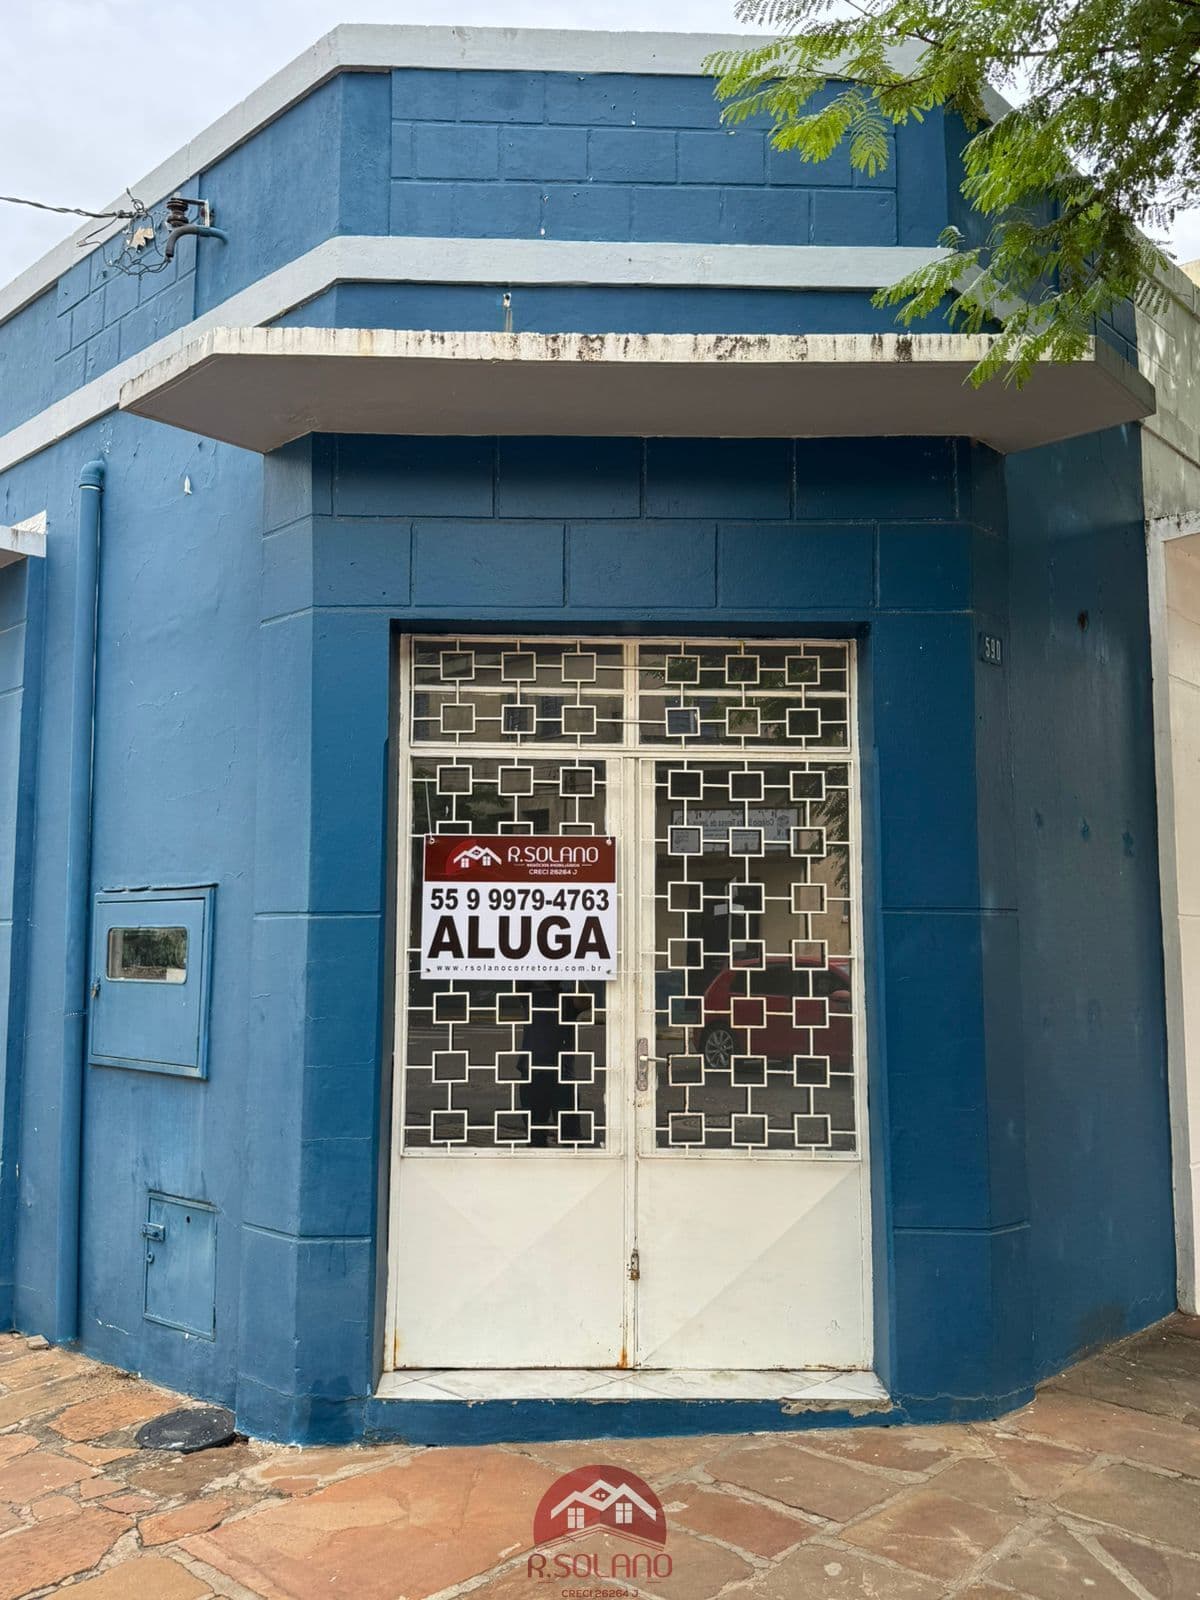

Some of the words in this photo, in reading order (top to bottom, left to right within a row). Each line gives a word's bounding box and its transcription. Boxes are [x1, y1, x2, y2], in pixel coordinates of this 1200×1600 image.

[507, 846, 599, 863] R.SOLANO
[528, 868, 549, 876] CRECI
[549, 868, 572, 876] 26264
[430, 888, 459, 911] 55
[466, 888, 480, 911] 9
[488, 888, 610, 912] 9979-4763
[427, 915, 611, 960] ALUGA
[436, 962, 602, 972] www.rsolanocorretora.com.br
